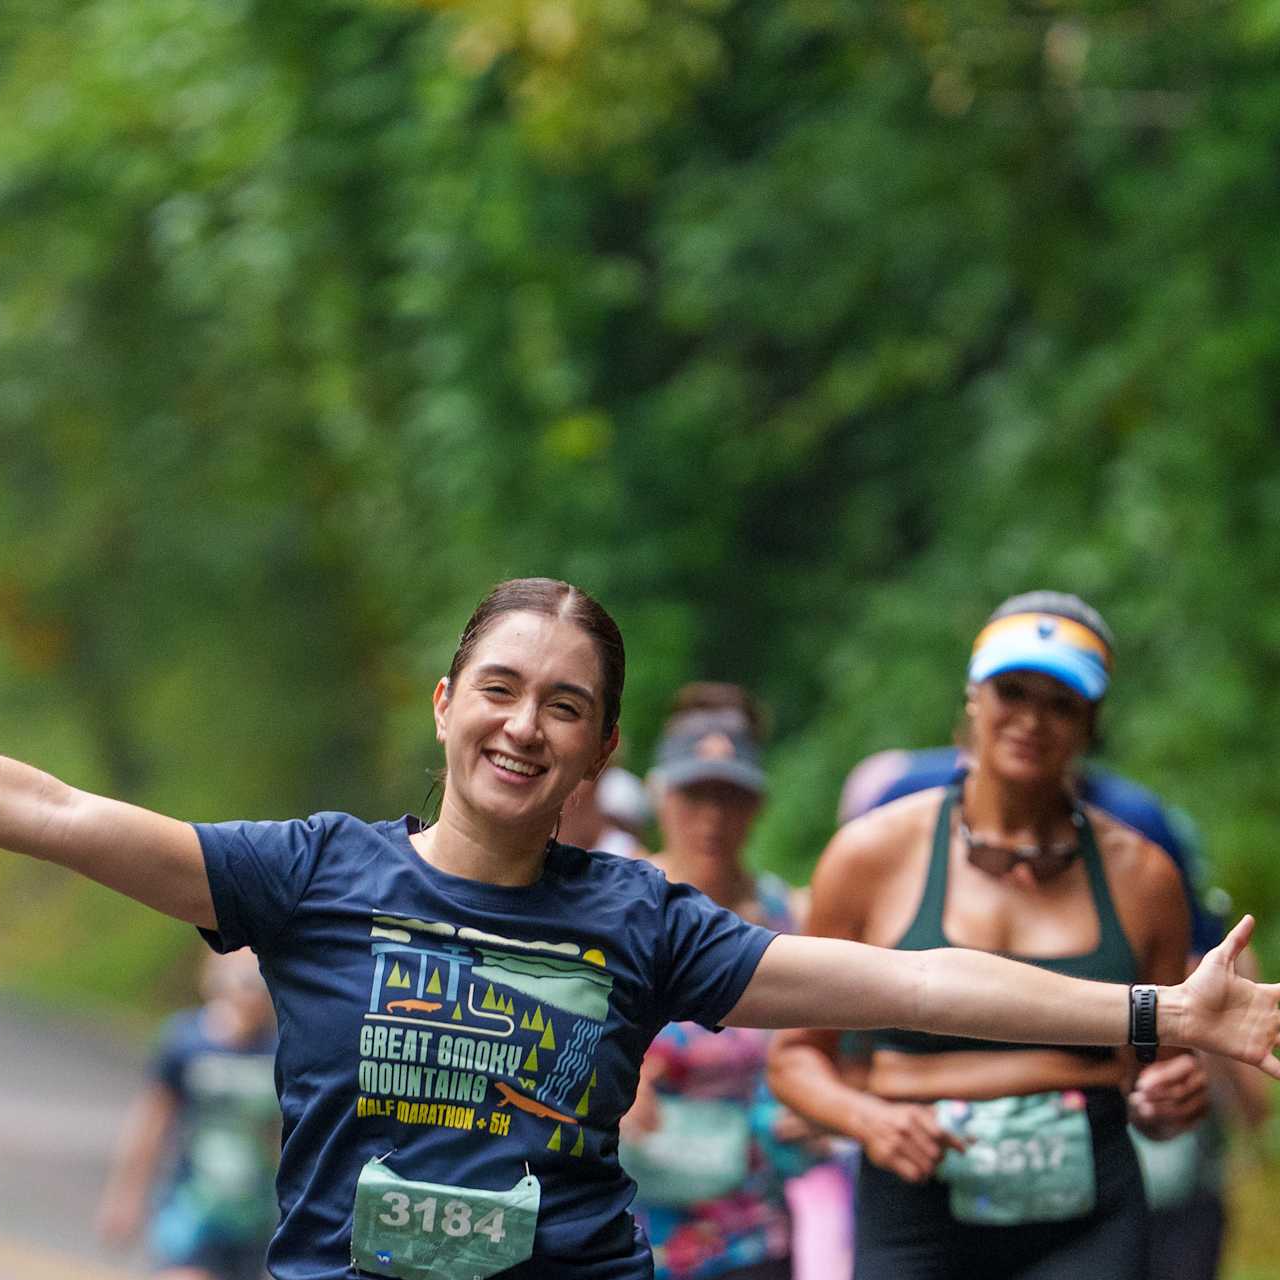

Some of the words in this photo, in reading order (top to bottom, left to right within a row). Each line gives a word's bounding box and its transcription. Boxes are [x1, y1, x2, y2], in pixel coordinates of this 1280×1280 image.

[360, 1025, 433, 1063] GREAT
[437, 1034, 523, 1077] SMOKY
[359, 1060, 488, 1103] MOUNTAINS
[357, 1096, 395, 1118] HALF
[396, 1100, 475, 1130] MARATHON
[489, 1111, 511, 1136] 5K
[378, 1191, 506, 1243] 3184
